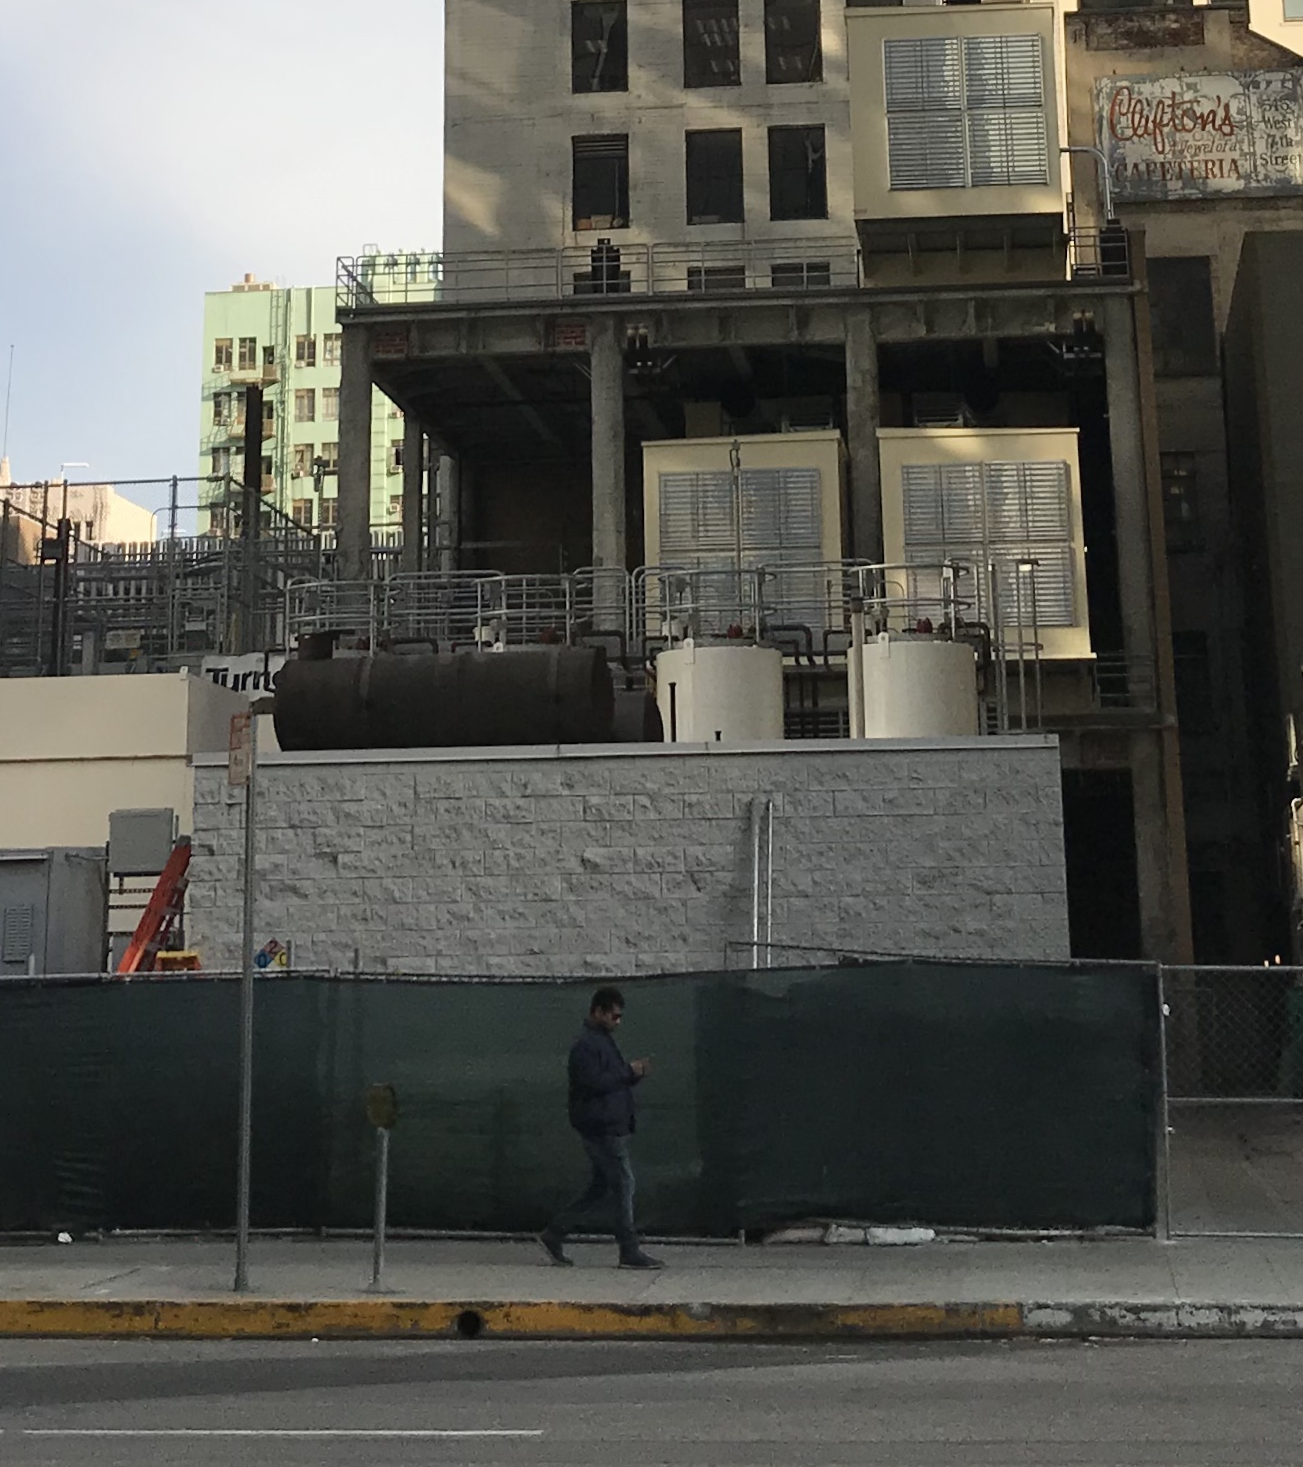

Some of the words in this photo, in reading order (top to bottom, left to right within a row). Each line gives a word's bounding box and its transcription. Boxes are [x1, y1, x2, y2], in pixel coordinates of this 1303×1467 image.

[1109, 86, 1239, 154] Clifton's
[1114, 157, 1241, 182] CAFETERIA
[205, 666, 276, 693] Turn
